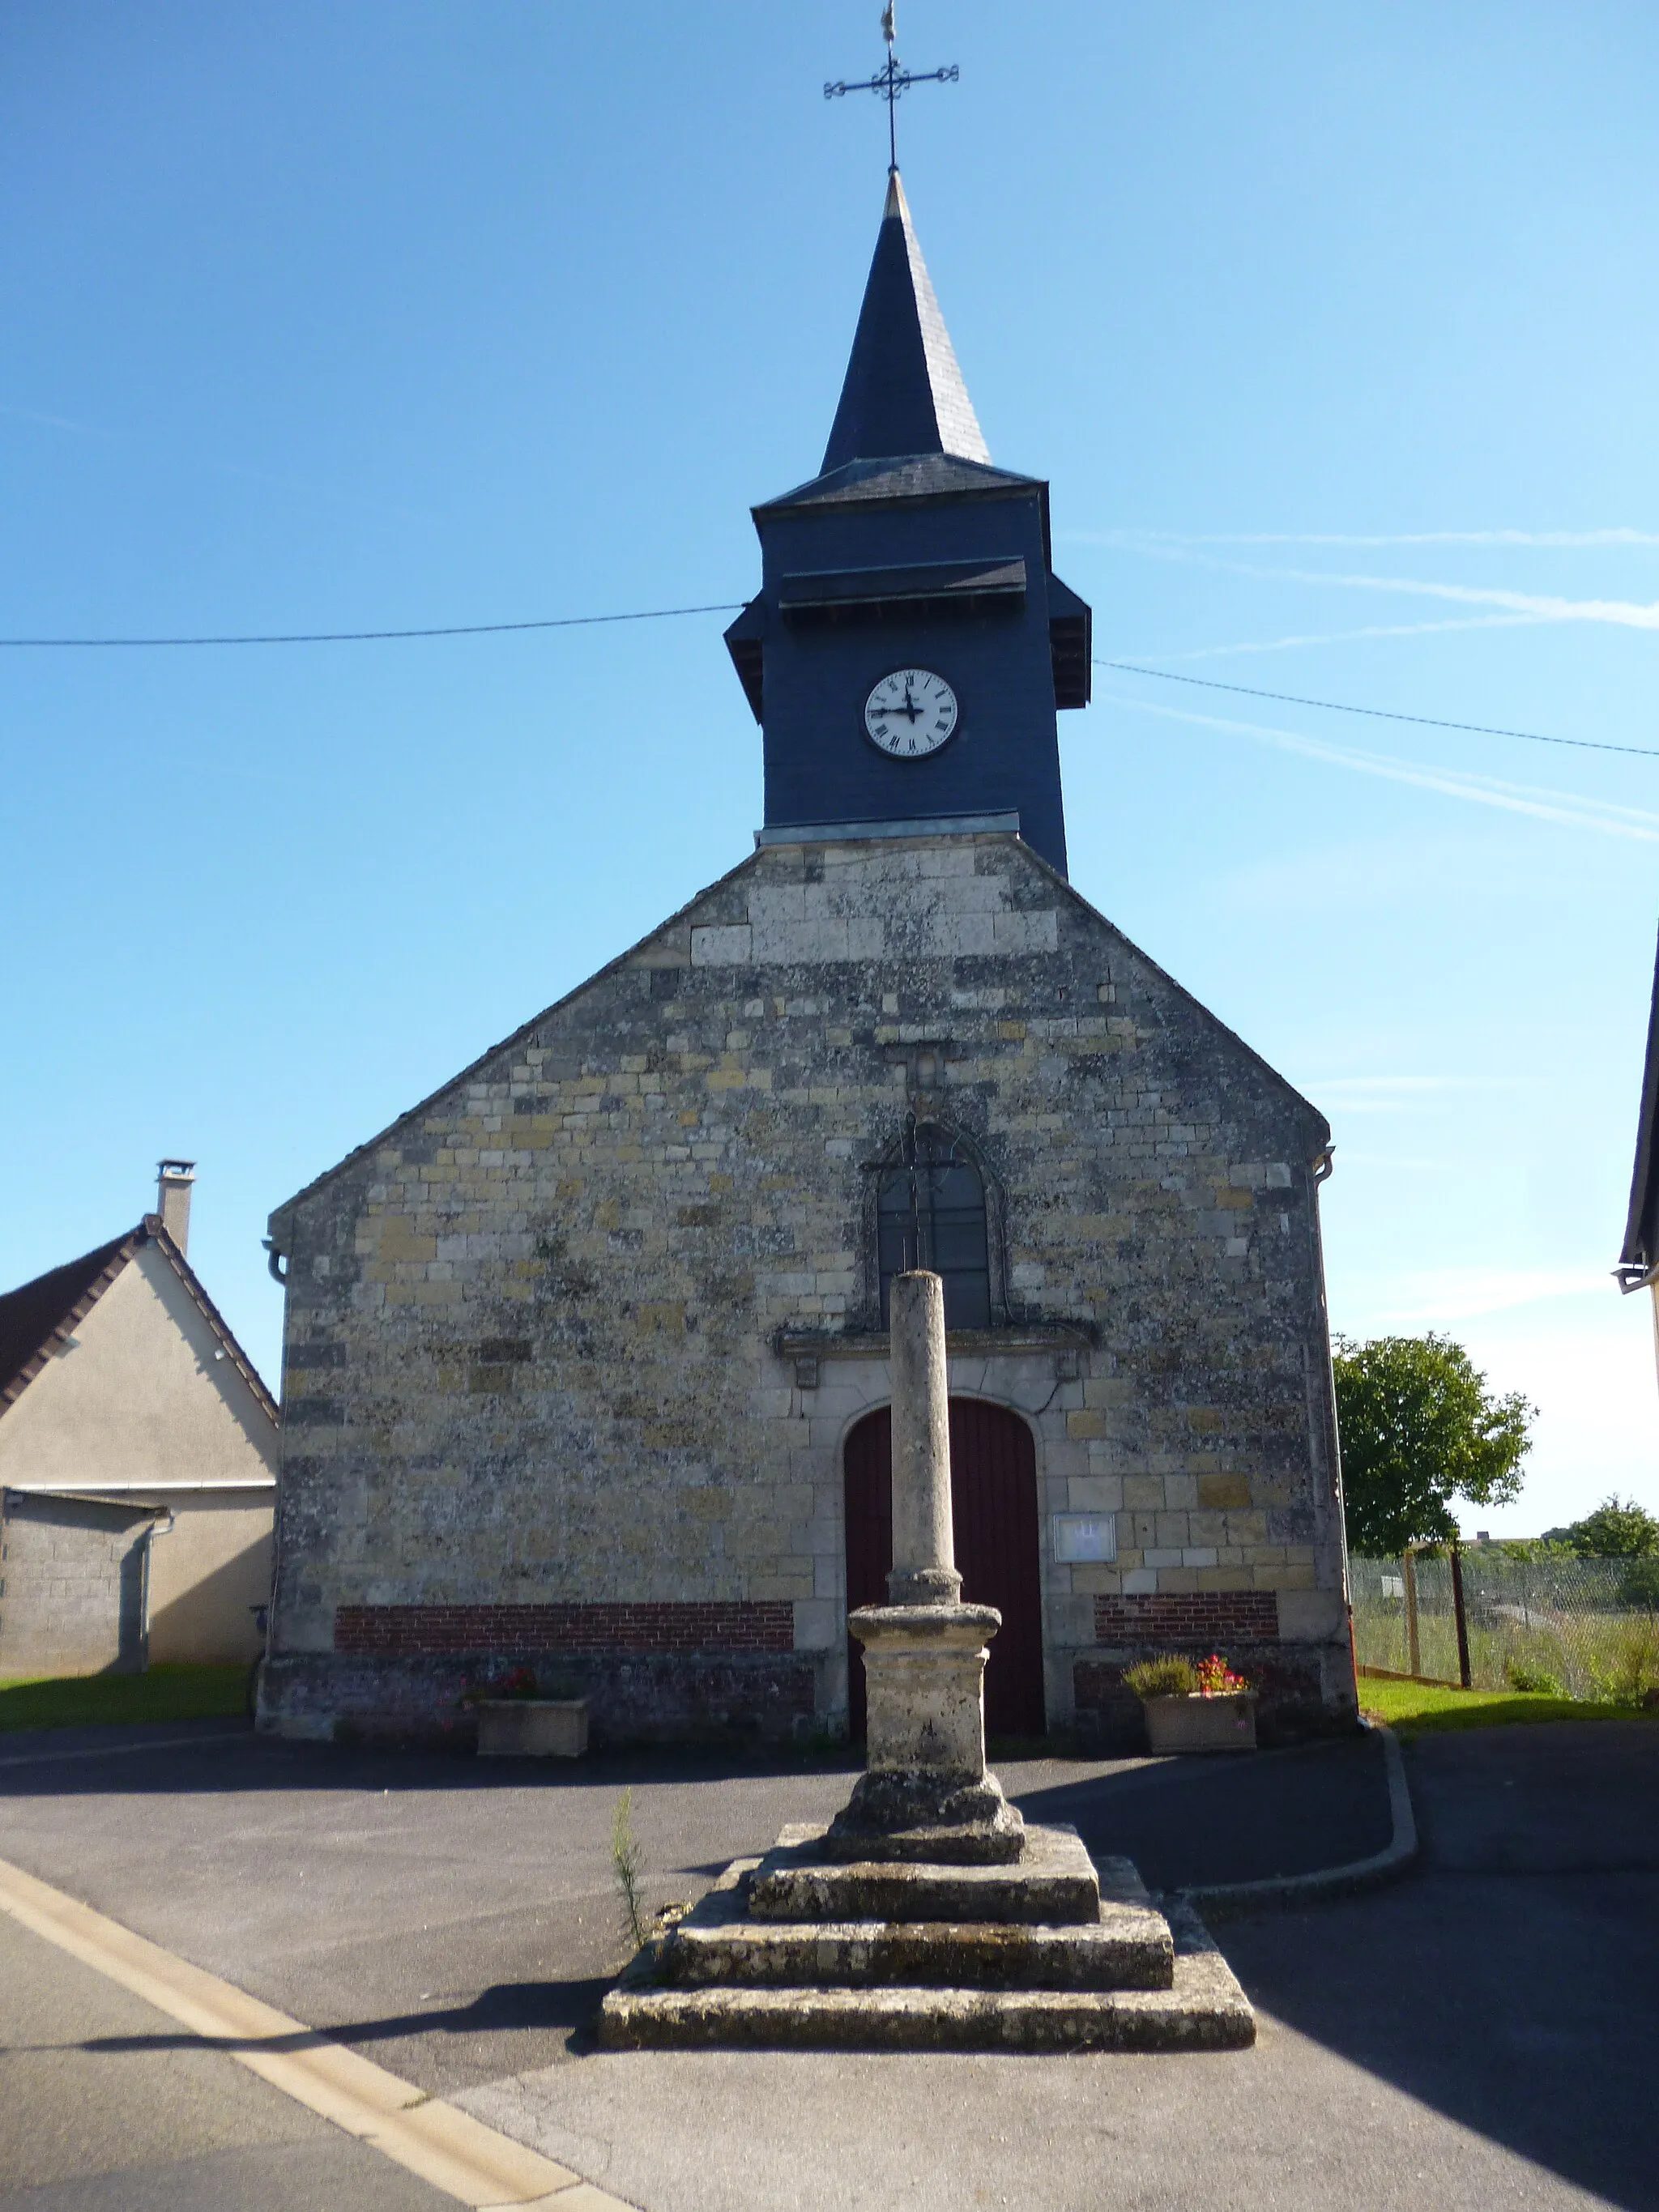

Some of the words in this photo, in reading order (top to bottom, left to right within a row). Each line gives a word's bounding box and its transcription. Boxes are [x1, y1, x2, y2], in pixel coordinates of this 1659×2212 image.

[923, 676, 932, 689] I
[934, 689, 947, 699] II
[889, 735, 900, 748] VII
[908, 738, 916, 750] VI
